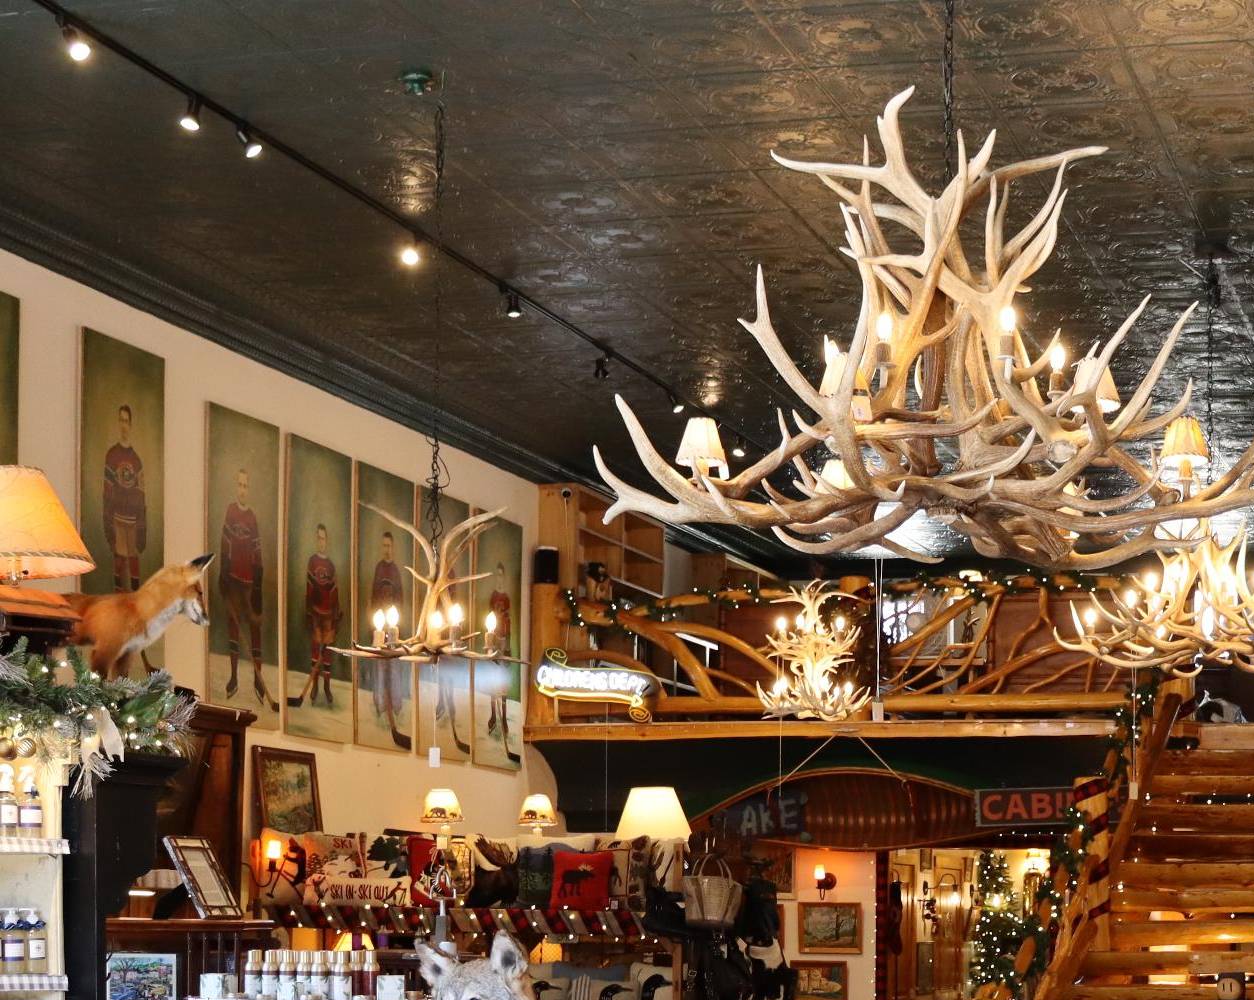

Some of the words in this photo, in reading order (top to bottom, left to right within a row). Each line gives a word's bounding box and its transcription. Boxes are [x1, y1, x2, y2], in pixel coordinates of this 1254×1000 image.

[332, 837, 353, 849] SKI
[330, 884, 344, 900] SKI
[357, 884, 372, 900] SKI
